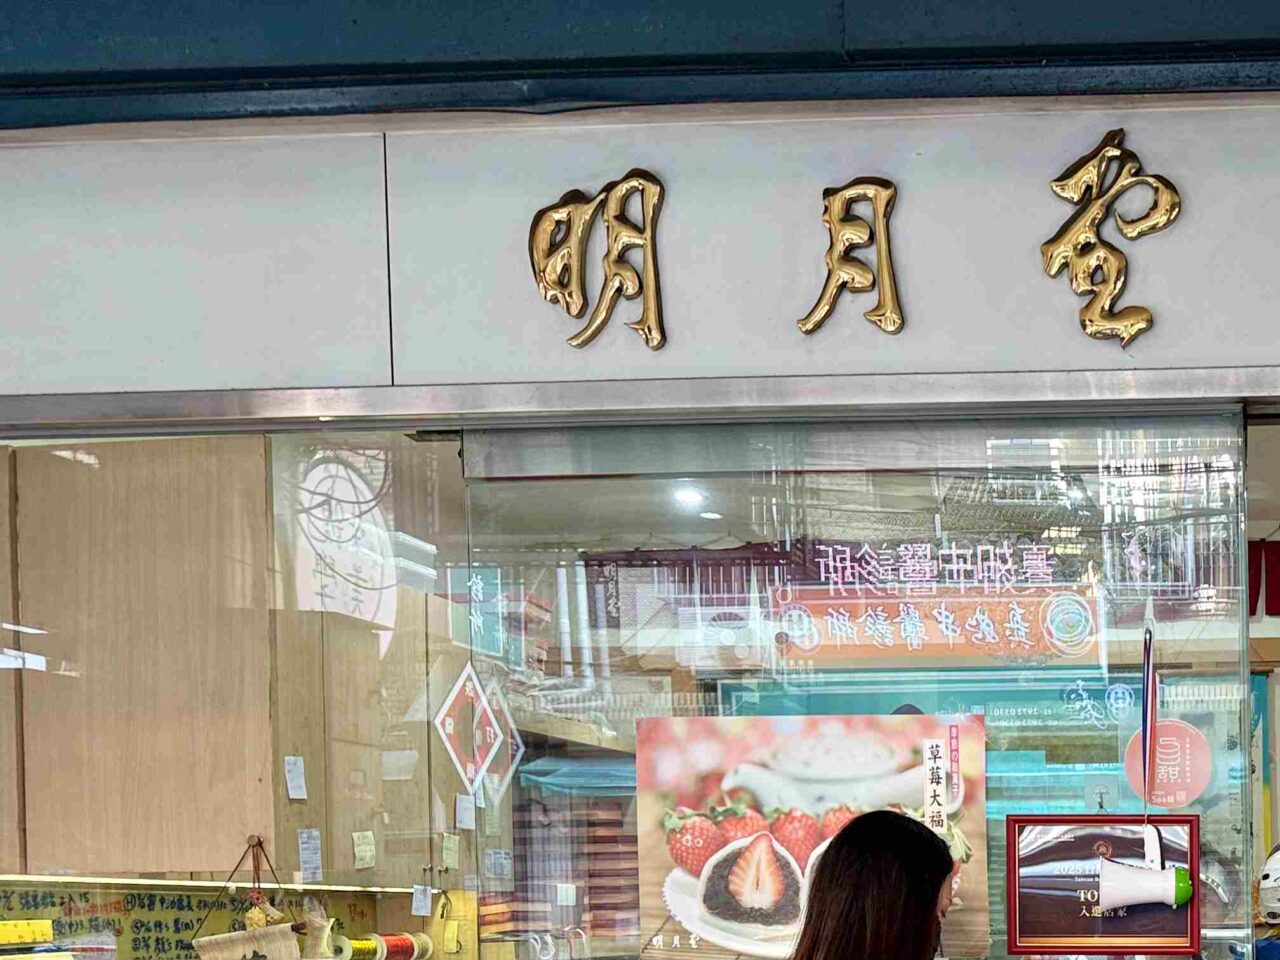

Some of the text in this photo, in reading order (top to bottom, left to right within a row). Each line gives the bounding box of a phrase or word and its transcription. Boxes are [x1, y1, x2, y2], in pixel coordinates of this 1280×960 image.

[529, 128, 1183, 350] 明月堂
[927, 743, 944, 829] 草莓大福
[1077, 889, 1099, 902] TO
[652, 934, 700, 949] 明月堂
